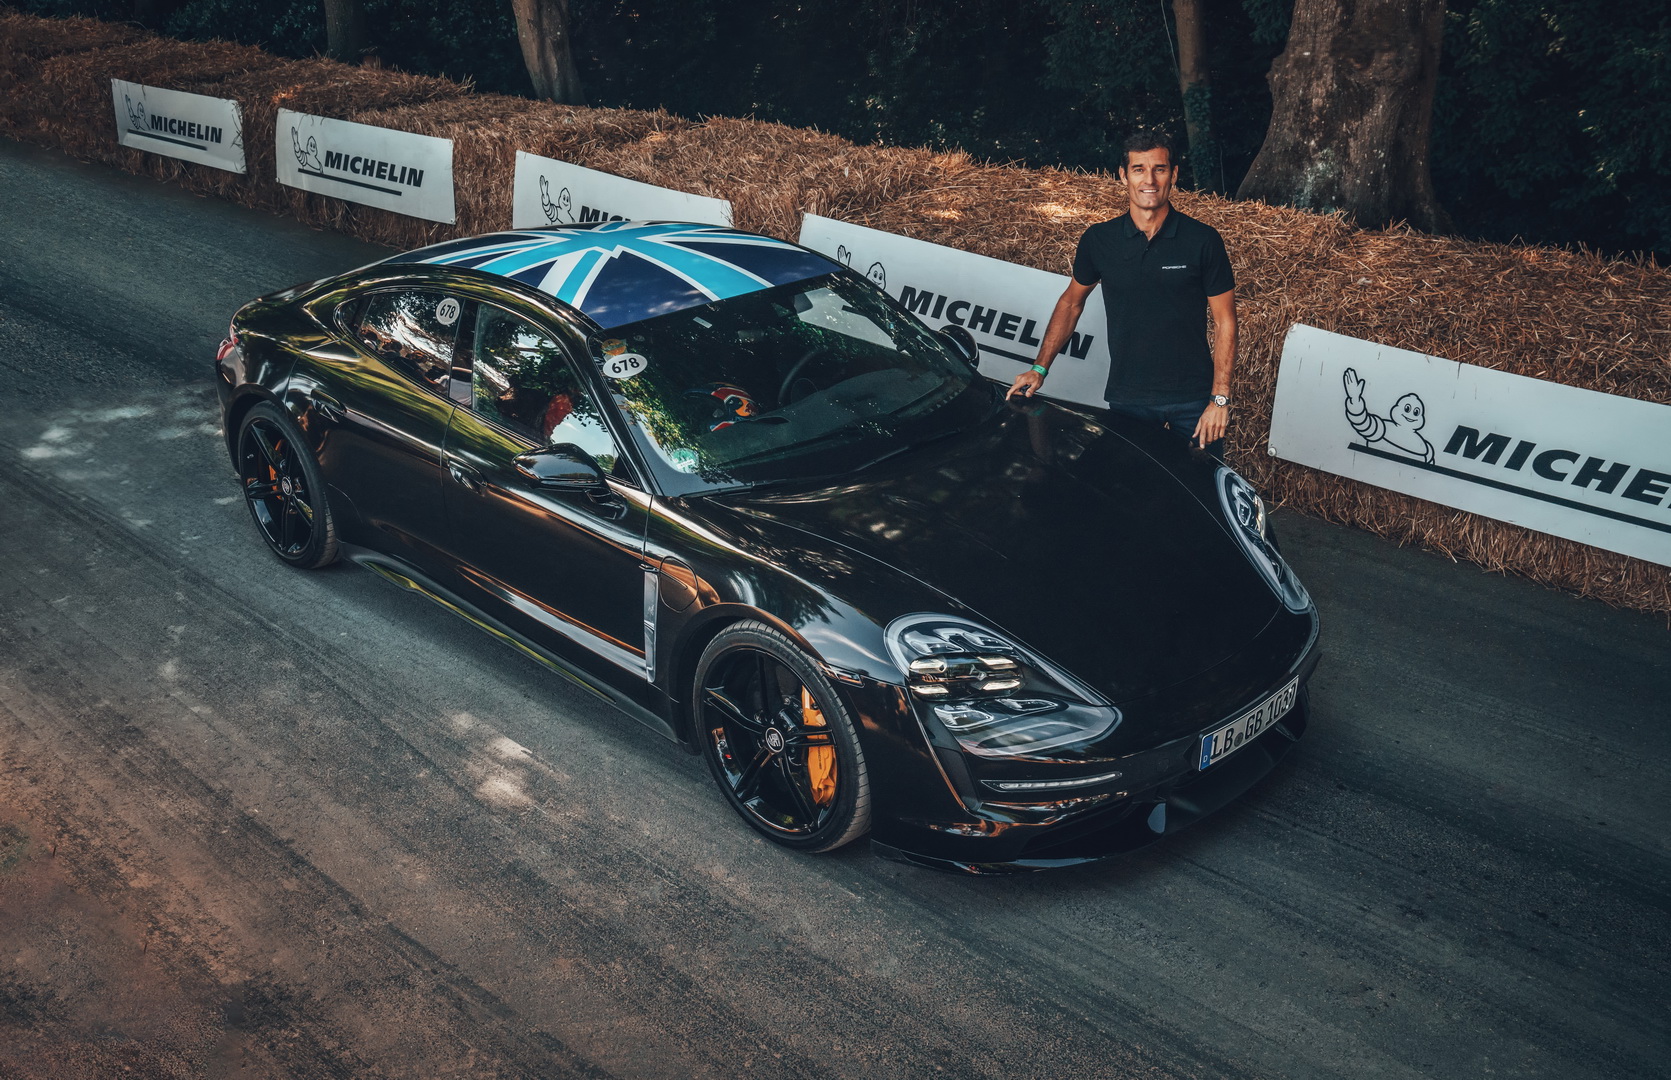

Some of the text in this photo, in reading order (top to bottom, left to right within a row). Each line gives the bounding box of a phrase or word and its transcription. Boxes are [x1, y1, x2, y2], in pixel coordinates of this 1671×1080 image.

[150, 114, 222, 144] MICHELIN
[324, 150, 424, 188] MICHELIN
[440, 304, 456, 319] 678
[902, 285, 1094, 360] MICHELN
[611, 357, 640, 374] 678
[1443, 425, 1671, 510] MICHE
[1210, 727, 1235, 760] LB
[1245, 709, 1263, 740] GB
